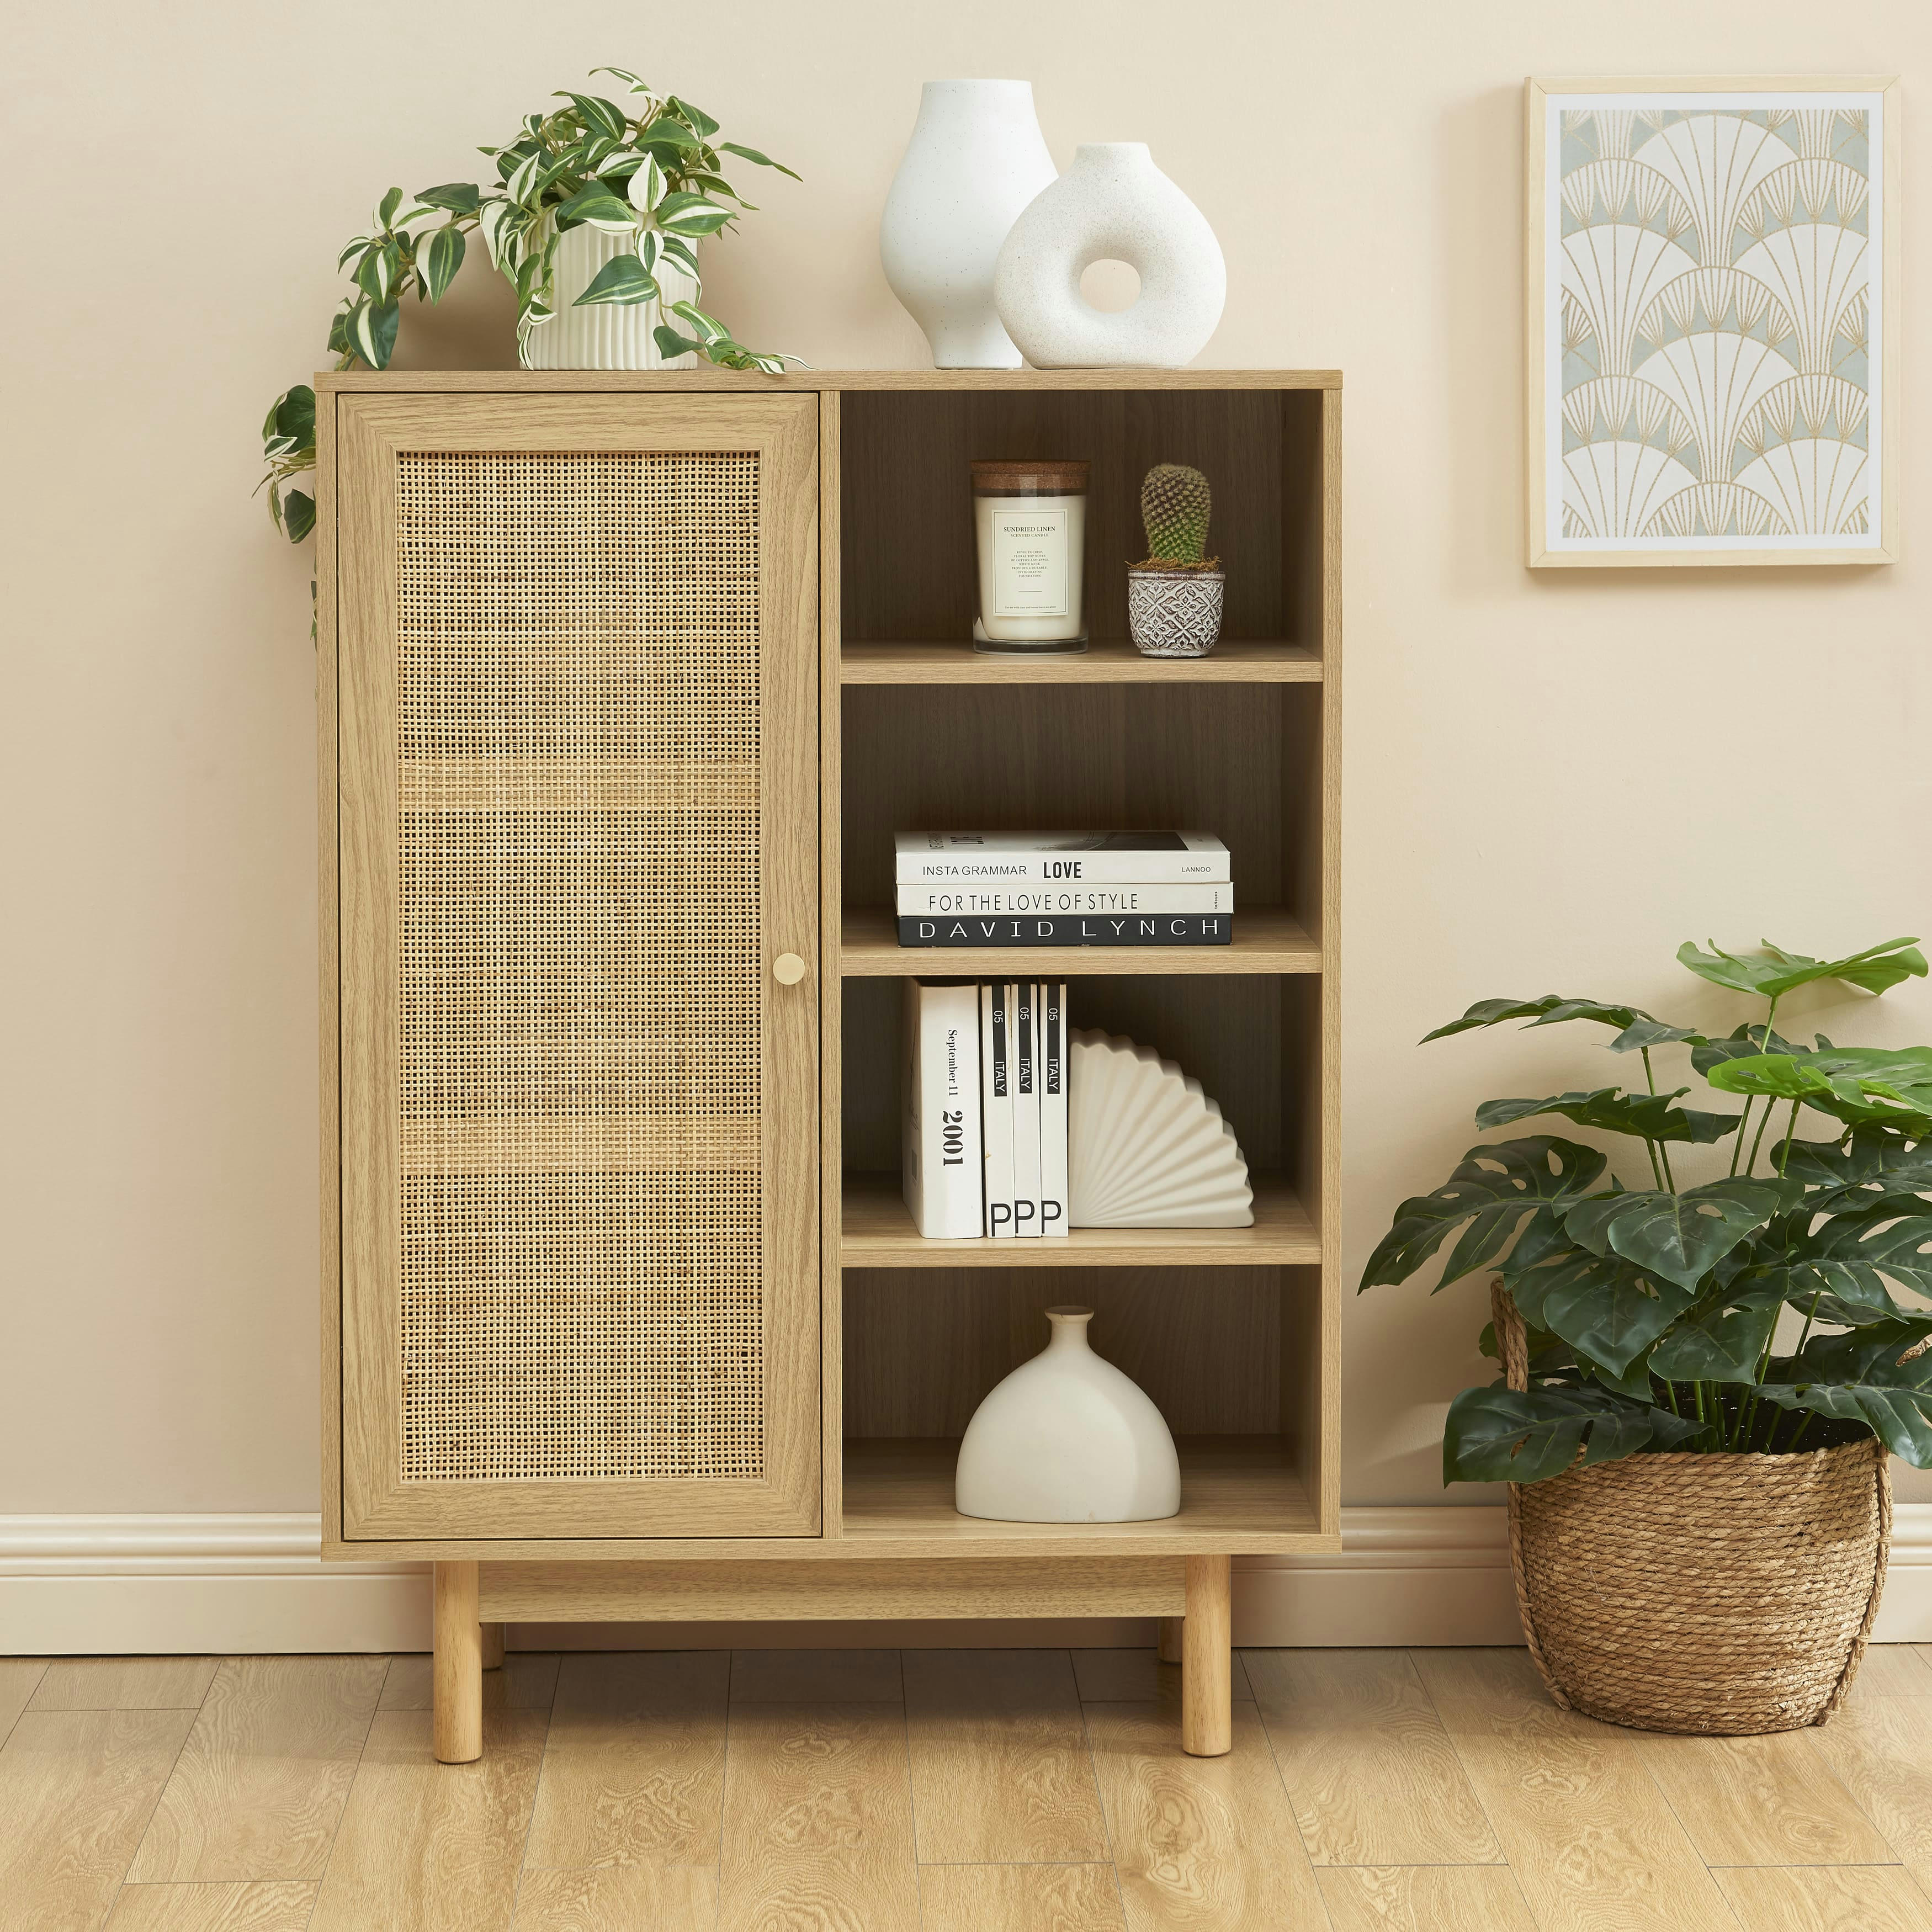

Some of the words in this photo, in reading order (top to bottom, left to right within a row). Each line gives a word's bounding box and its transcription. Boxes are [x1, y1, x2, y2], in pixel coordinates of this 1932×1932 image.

[1043, 862, 1081, 879] LOVE
[930, 895, 963, 911] FOR
[969, 895, 1001, 911] THE
[1009, 894, 1052, 911] LOVE
[1059, 894, 1081, 910] OF
[1088, 894, 1138, 910] STYLE
[920, 921, 1054, 938] DAVID
[1082, 919, 1218, 936] LYNCH
[994, 1010, 1003, 1023] 05
[1020, 1007, 1029, 1020] 05
[1048, 1008, 1058, 1021] 05
[946, 1029, 958, 1084] September
[995, 1061, 1005, 1092] ITALY
[1021, 1058, 1031, 1089] ITALY
[1049, 1059, 1059, 1090] ITALY
[949, 1086, 958, 1096] 11
[942, 1110, 963, 1166] 2001
